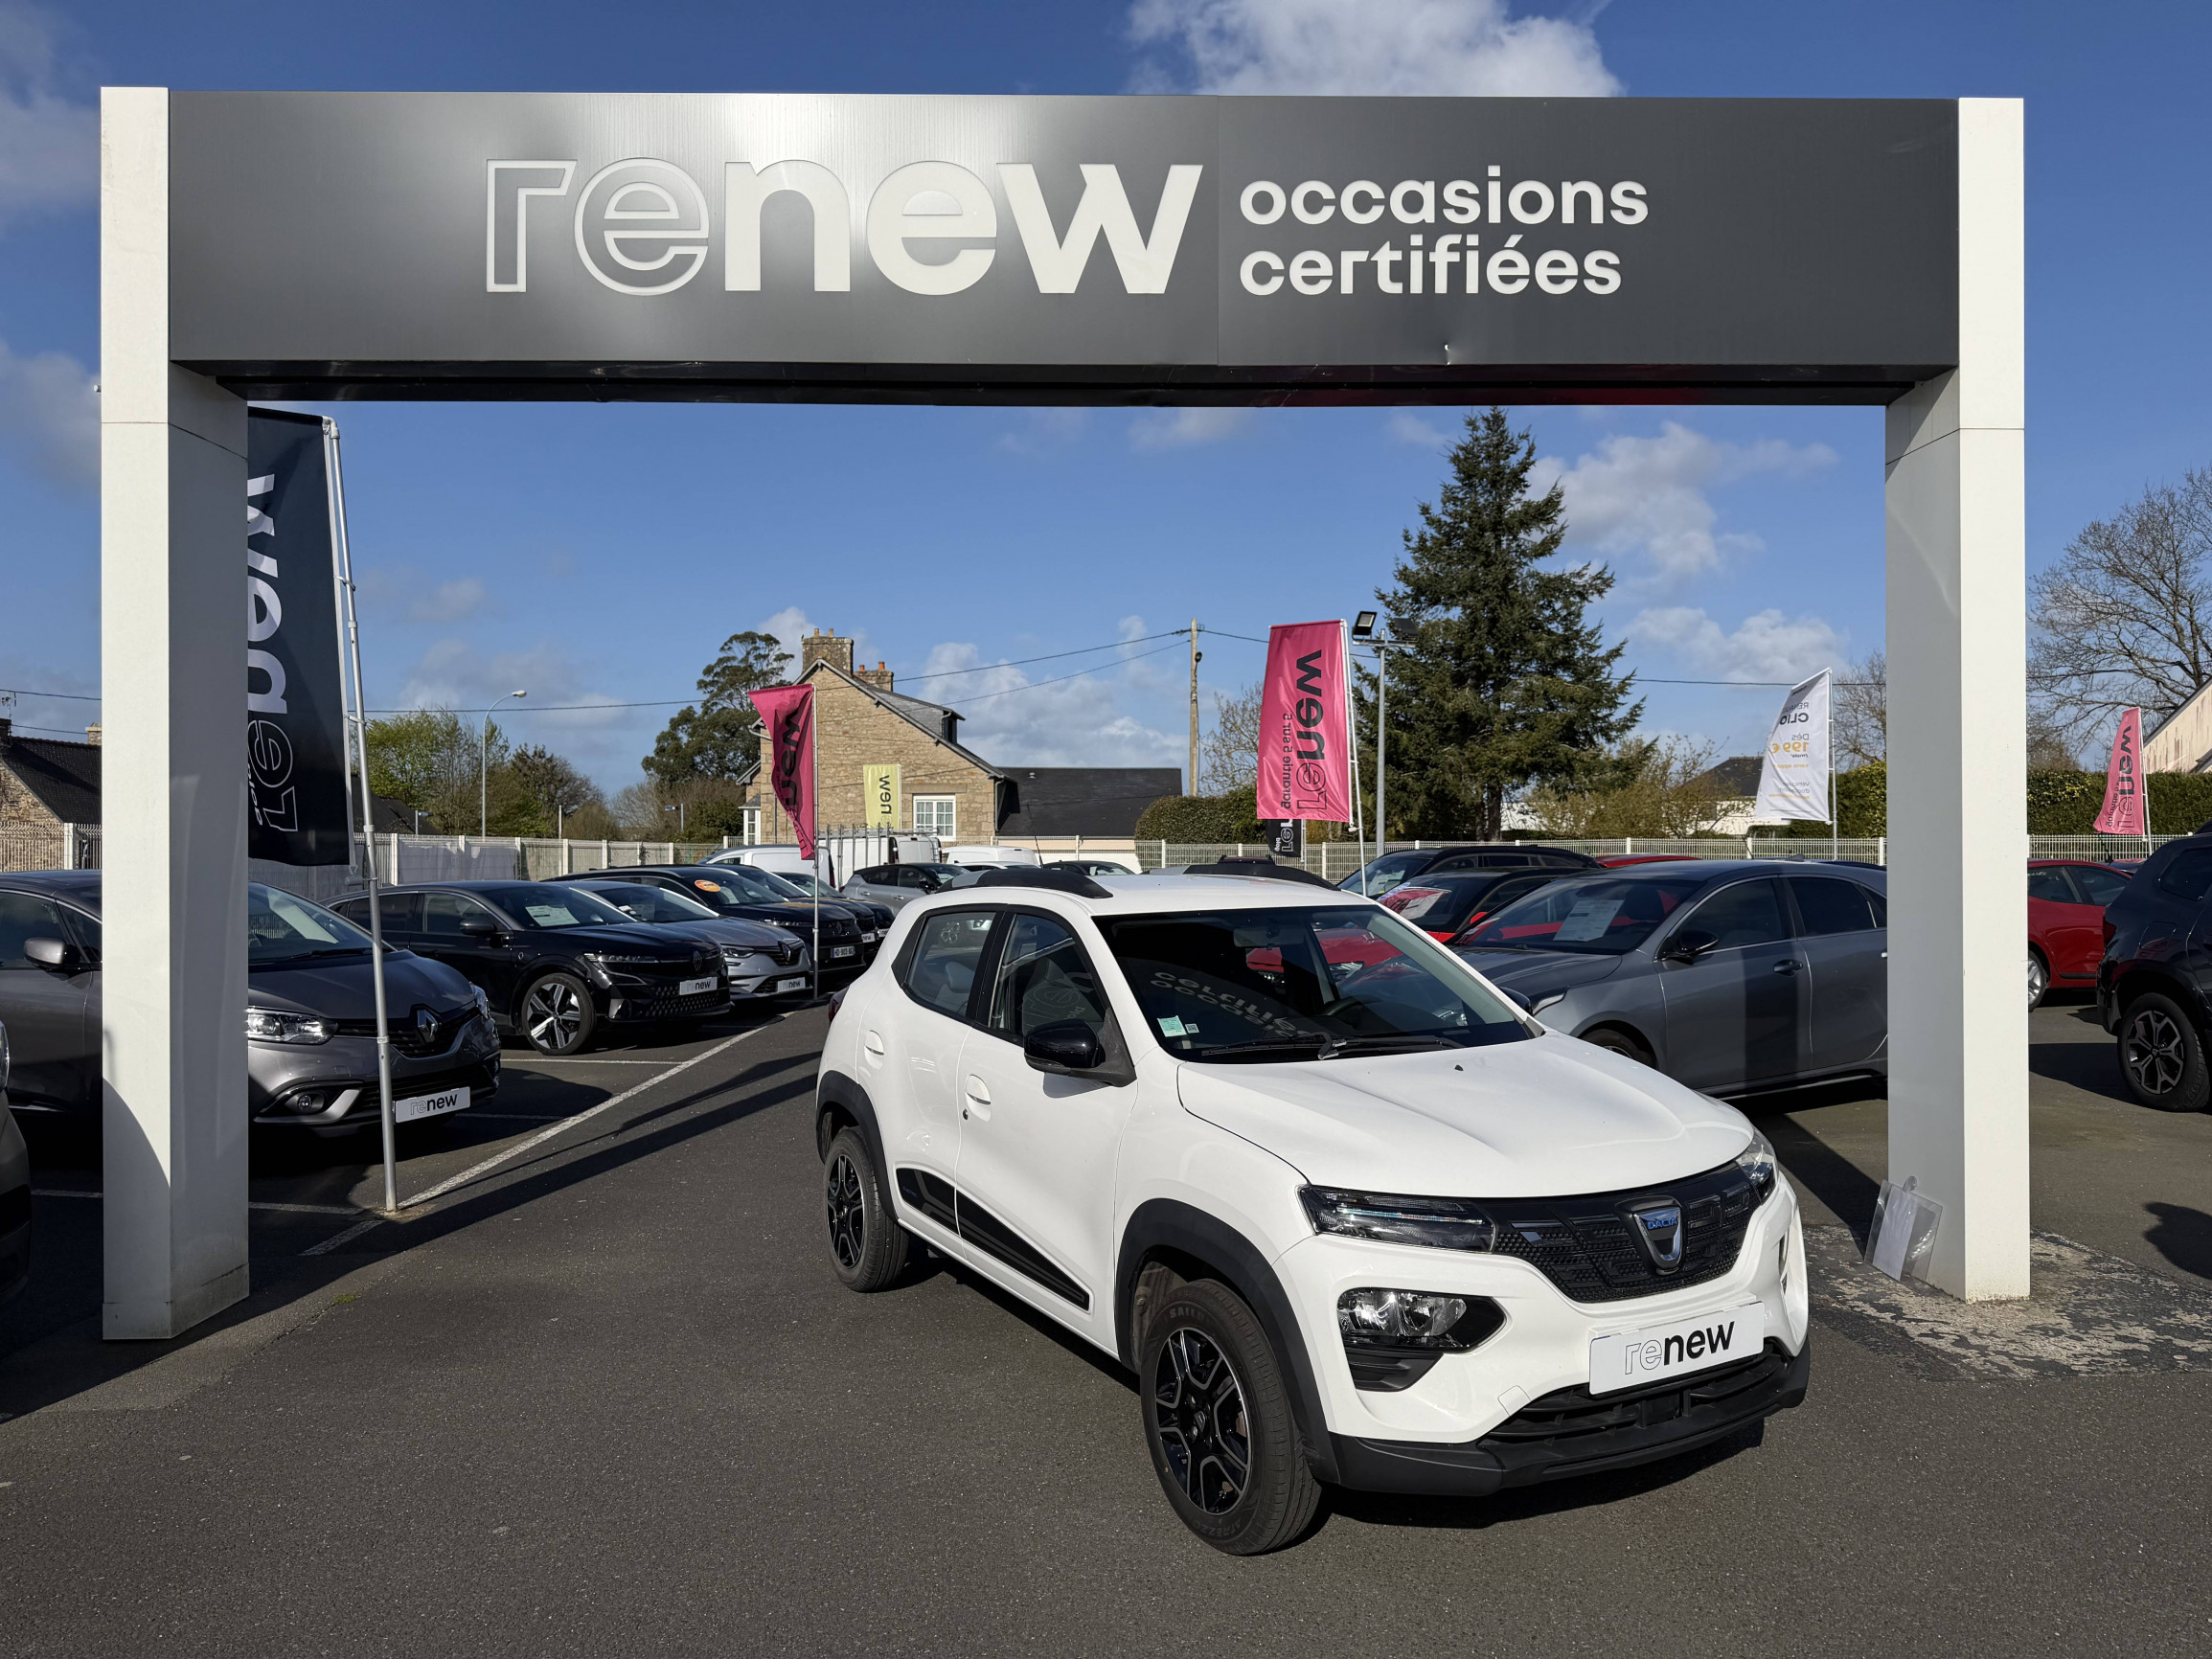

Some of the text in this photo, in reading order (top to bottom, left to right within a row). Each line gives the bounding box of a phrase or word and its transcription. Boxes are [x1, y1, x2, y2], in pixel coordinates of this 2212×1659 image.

[1240, 165, 1649, 225] occasions
[487, 157, 1203, 295] renew
[1240, 234, 1623, 295] certifiées
[410, 1094, 458, 1116] renew
[1647, 1216, 1677, 1230] DACIA
[1625, 1321, 1736, 1375] renew
